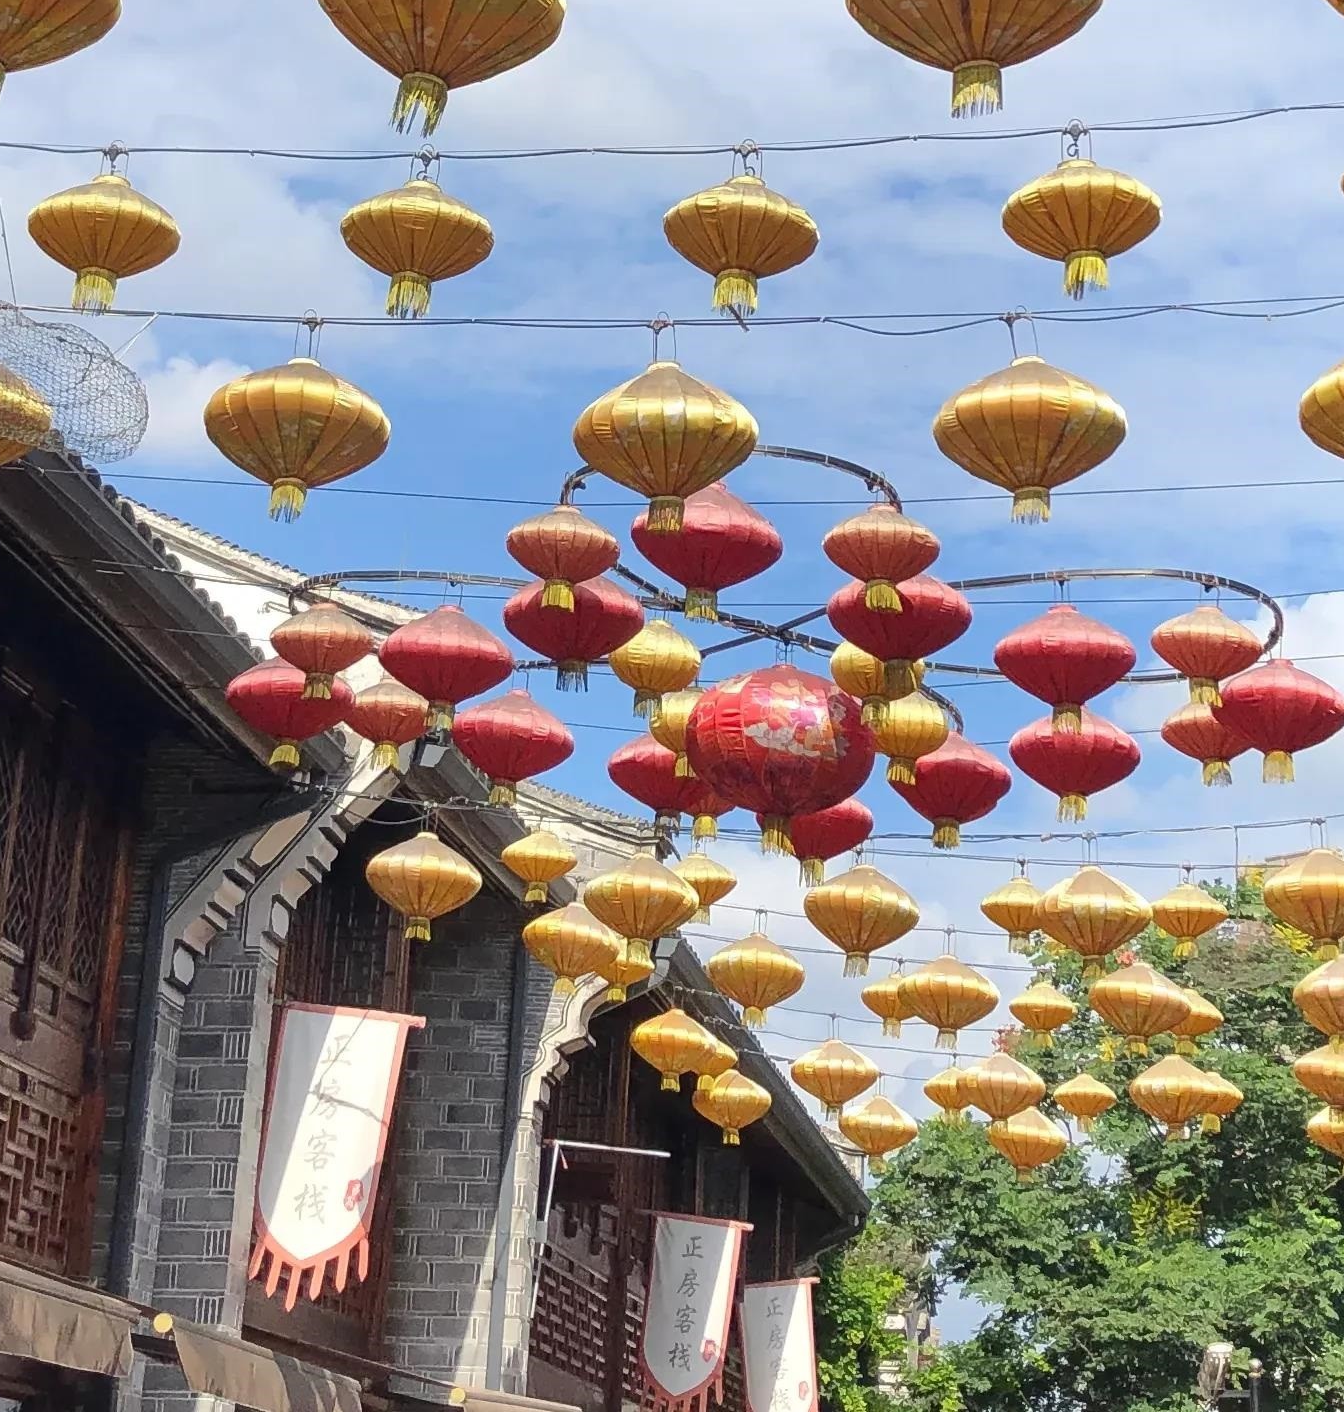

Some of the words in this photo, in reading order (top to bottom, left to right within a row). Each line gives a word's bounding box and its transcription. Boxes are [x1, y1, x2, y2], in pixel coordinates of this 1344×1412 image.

[293, 1033, 352, 1225] 正房客栈
[668, 1235, 704, 1372] 正房客栈
[766, 1296, 792, 1412] 正房客栈
